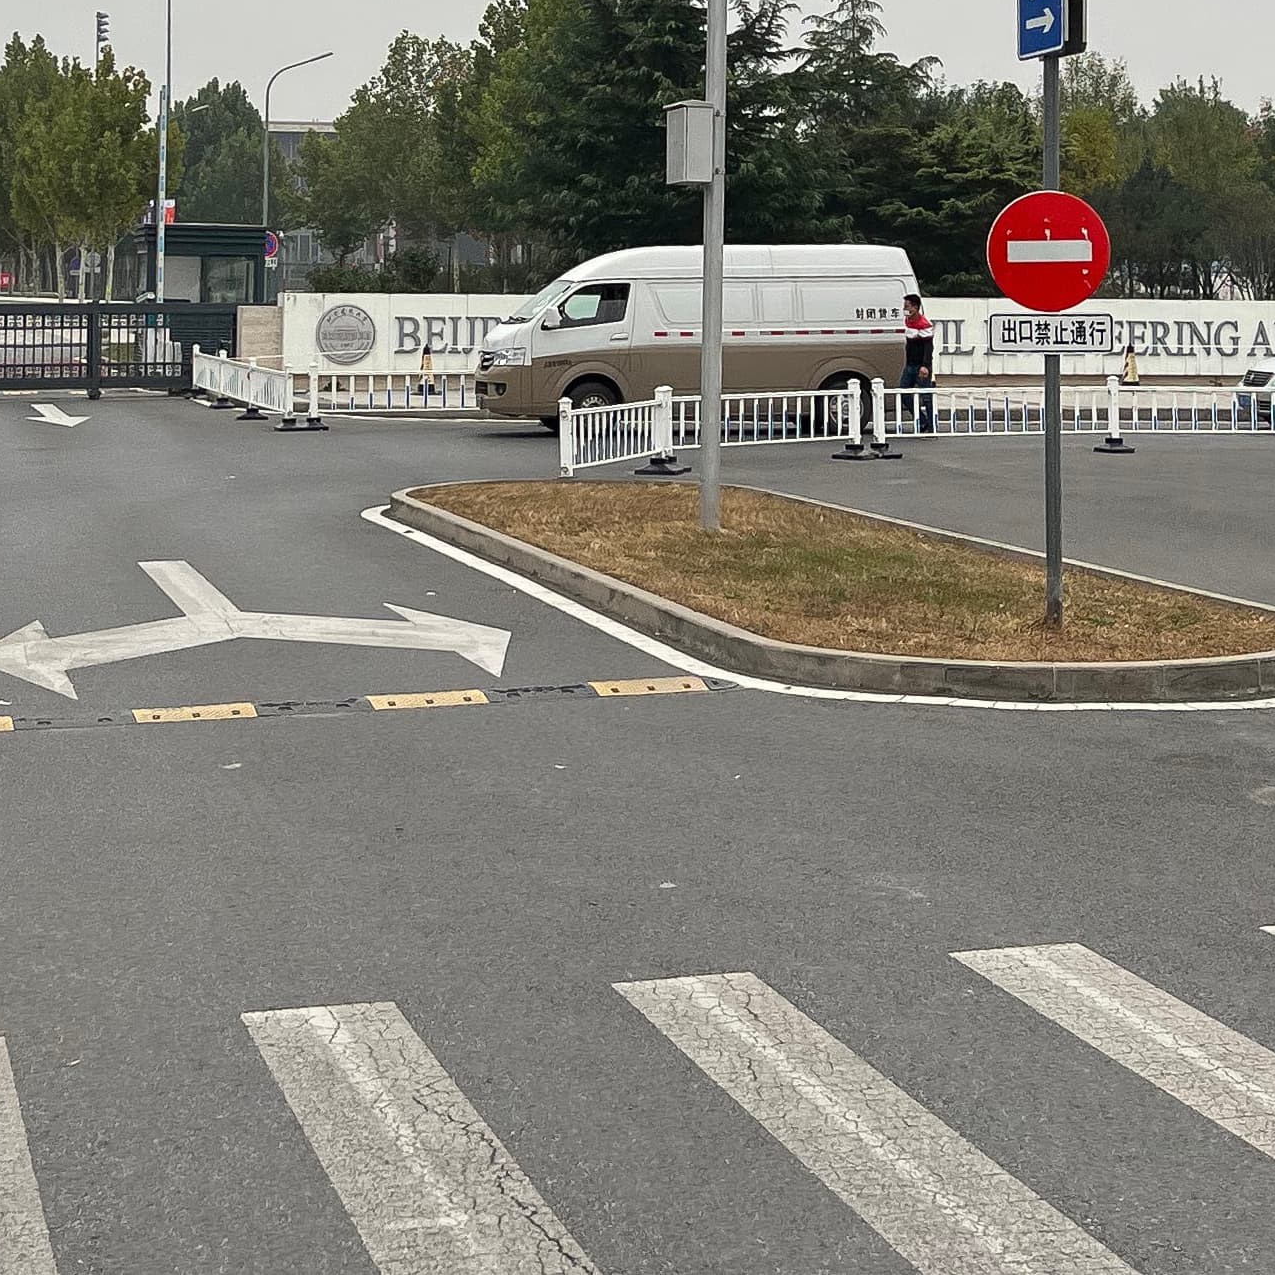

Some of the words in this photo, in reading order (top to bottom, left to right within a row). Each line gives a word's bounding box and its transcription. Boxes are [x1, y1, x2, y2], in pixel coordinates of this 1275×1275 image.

[1001, 319, 1107, 346] 出口禁止通行
